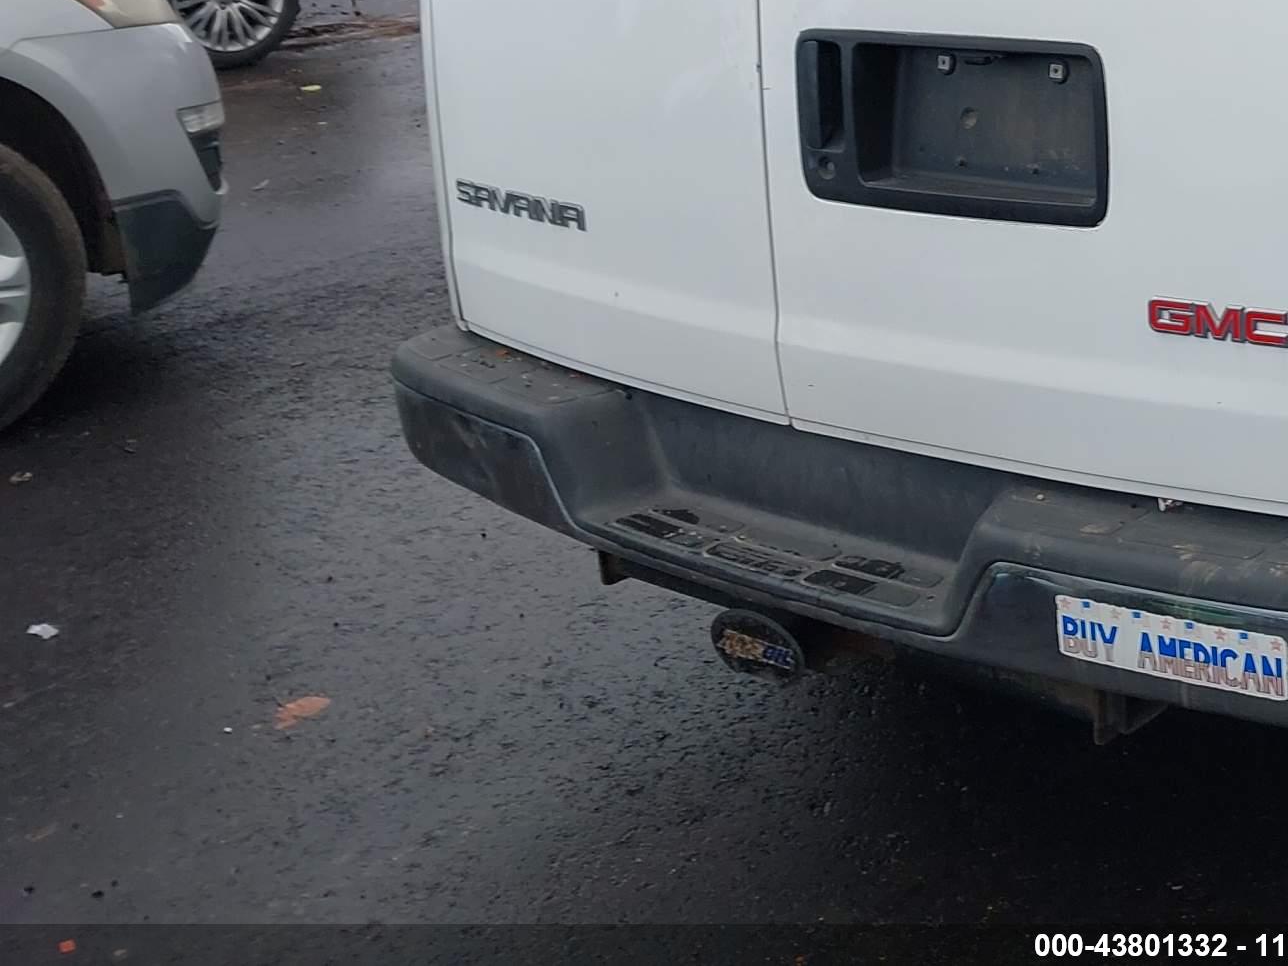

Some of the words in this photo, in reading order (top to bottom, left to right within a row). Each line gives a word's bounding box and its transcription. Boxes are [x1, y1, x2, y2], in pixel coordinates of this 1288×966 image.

[456, 178, 587, 232] SAVANA
[1061, 614, 1118, 663] BUY
[1137, 631, 1285, 697] AMERICAN
